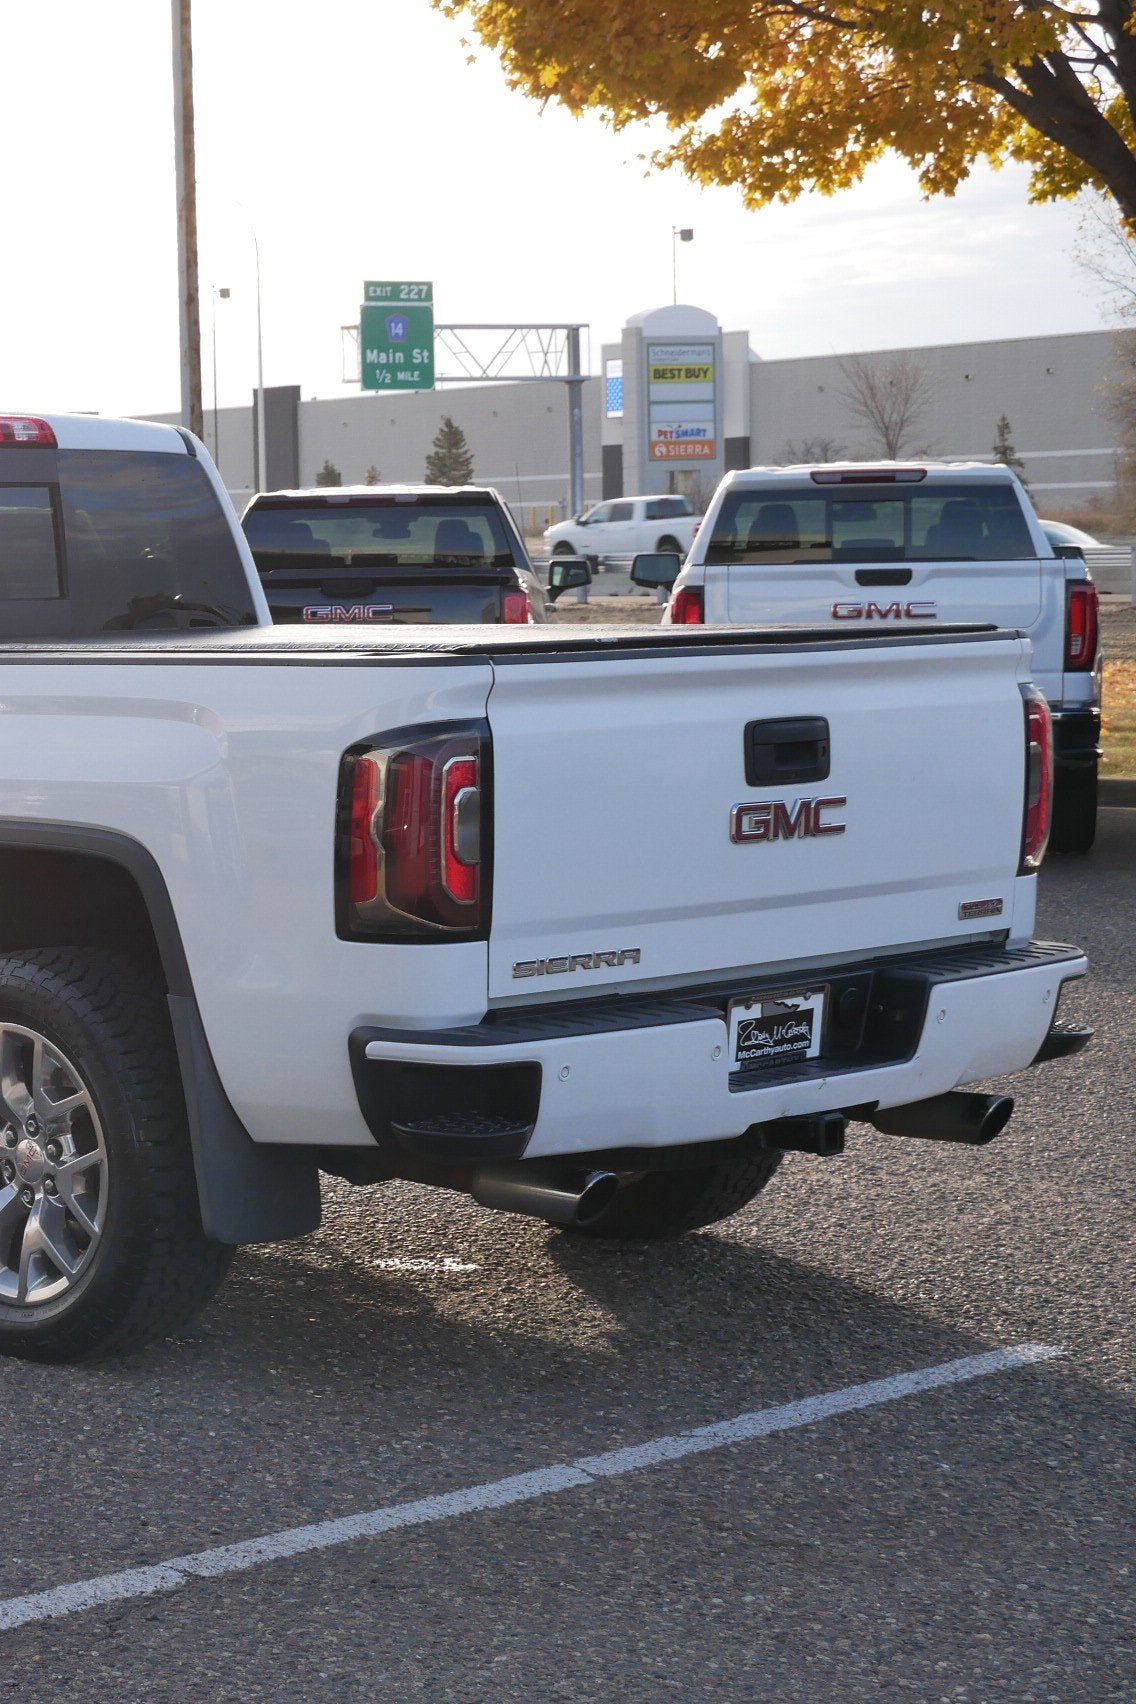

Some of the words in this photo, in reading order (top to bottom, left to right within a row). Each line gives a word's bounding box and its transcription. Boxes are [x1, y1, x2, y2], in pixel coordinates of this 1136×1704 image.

[368, 286, 392, 297] EXIT
[399, 285, 427, 299] 227
[390, 322, 404, 336] 14
[366, 348, 404, 364] Main
[412, 348, 430, 364] St
[397, 371, 421, 381] MILE
[653, 368, 683, 380] BEST
[685, 367, 710, 379] BUY
[668, 444, 711, 456] SIERRA
[303, 605, 393, 621] GMC
[831, 601, 937, 620] GMC
[730, 795, 847, 844] GMC
[512, 947, 641, 978] SIERRA
[738, 1040, 811, 1060] McCarthyauto.com
